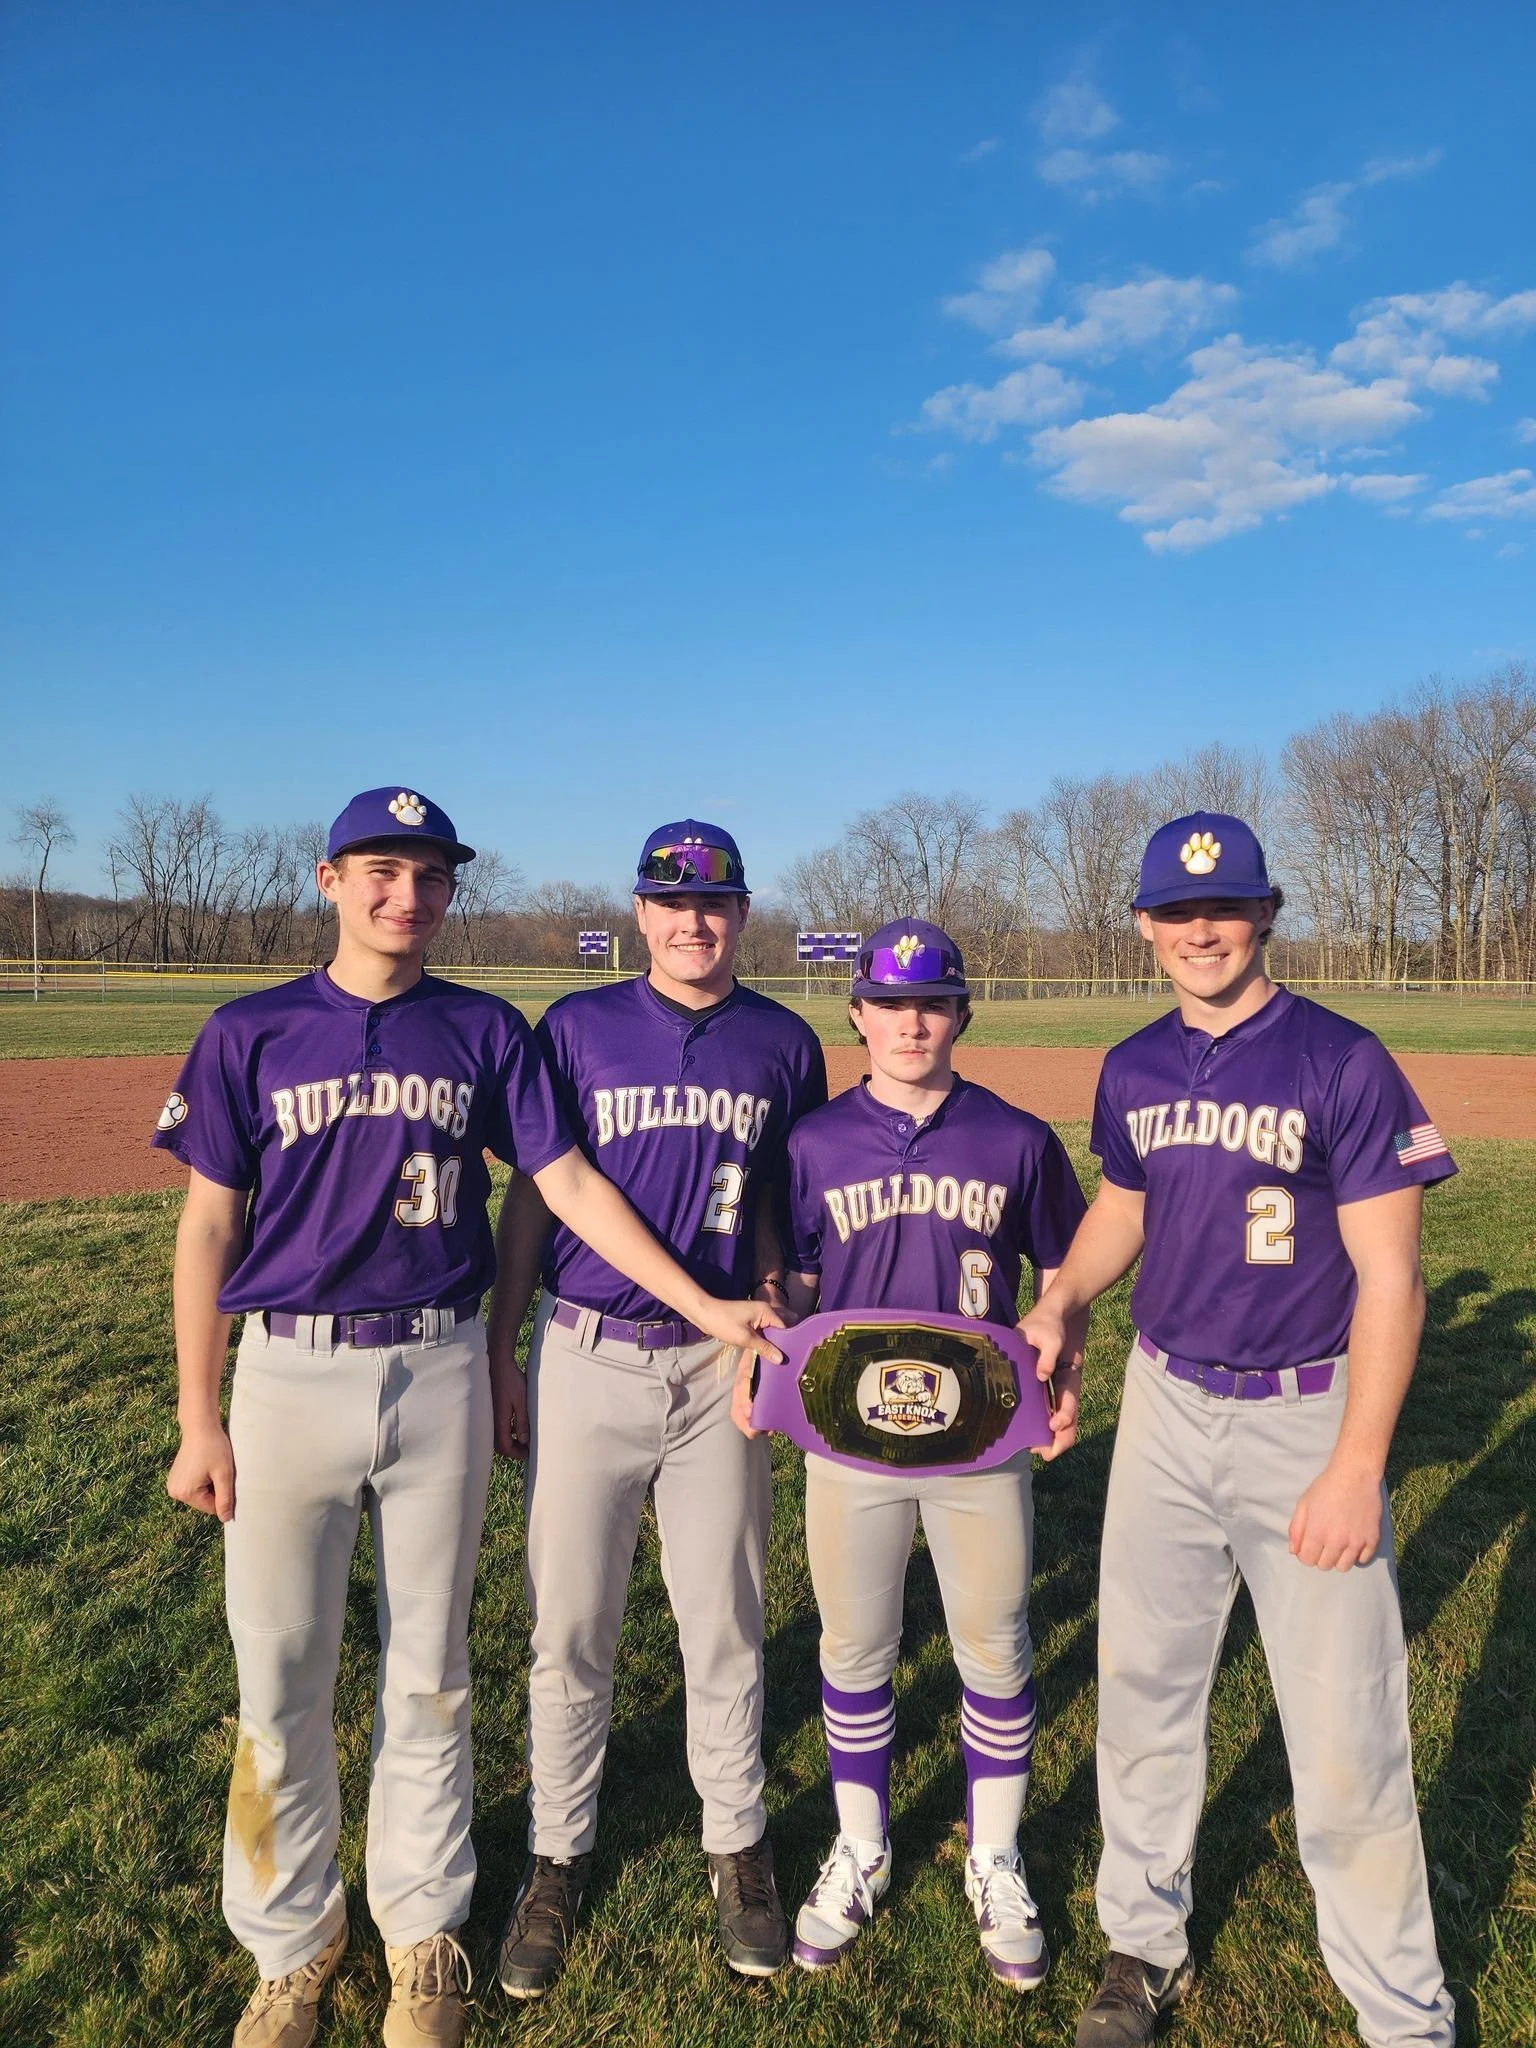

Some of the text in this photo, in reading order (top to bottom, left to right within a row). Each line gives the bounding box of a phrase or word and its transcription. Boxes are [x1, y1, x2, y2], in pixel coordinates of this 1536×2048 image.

[271, 1072, 475, 1151] BULLDOGS
[594, 1085, 772, 1152] BULLDOGS
[394, 1152, 462, 1229] 30
[701, 1162, 752, 1236] 2
[824, 1173, 1008, 1244] BULLDOGS
[1246, 1186, 1295, 1264] 2
[958, 1249, 993, 1318] 6
[878, 1404, 938, 1420] EAST KNOX
